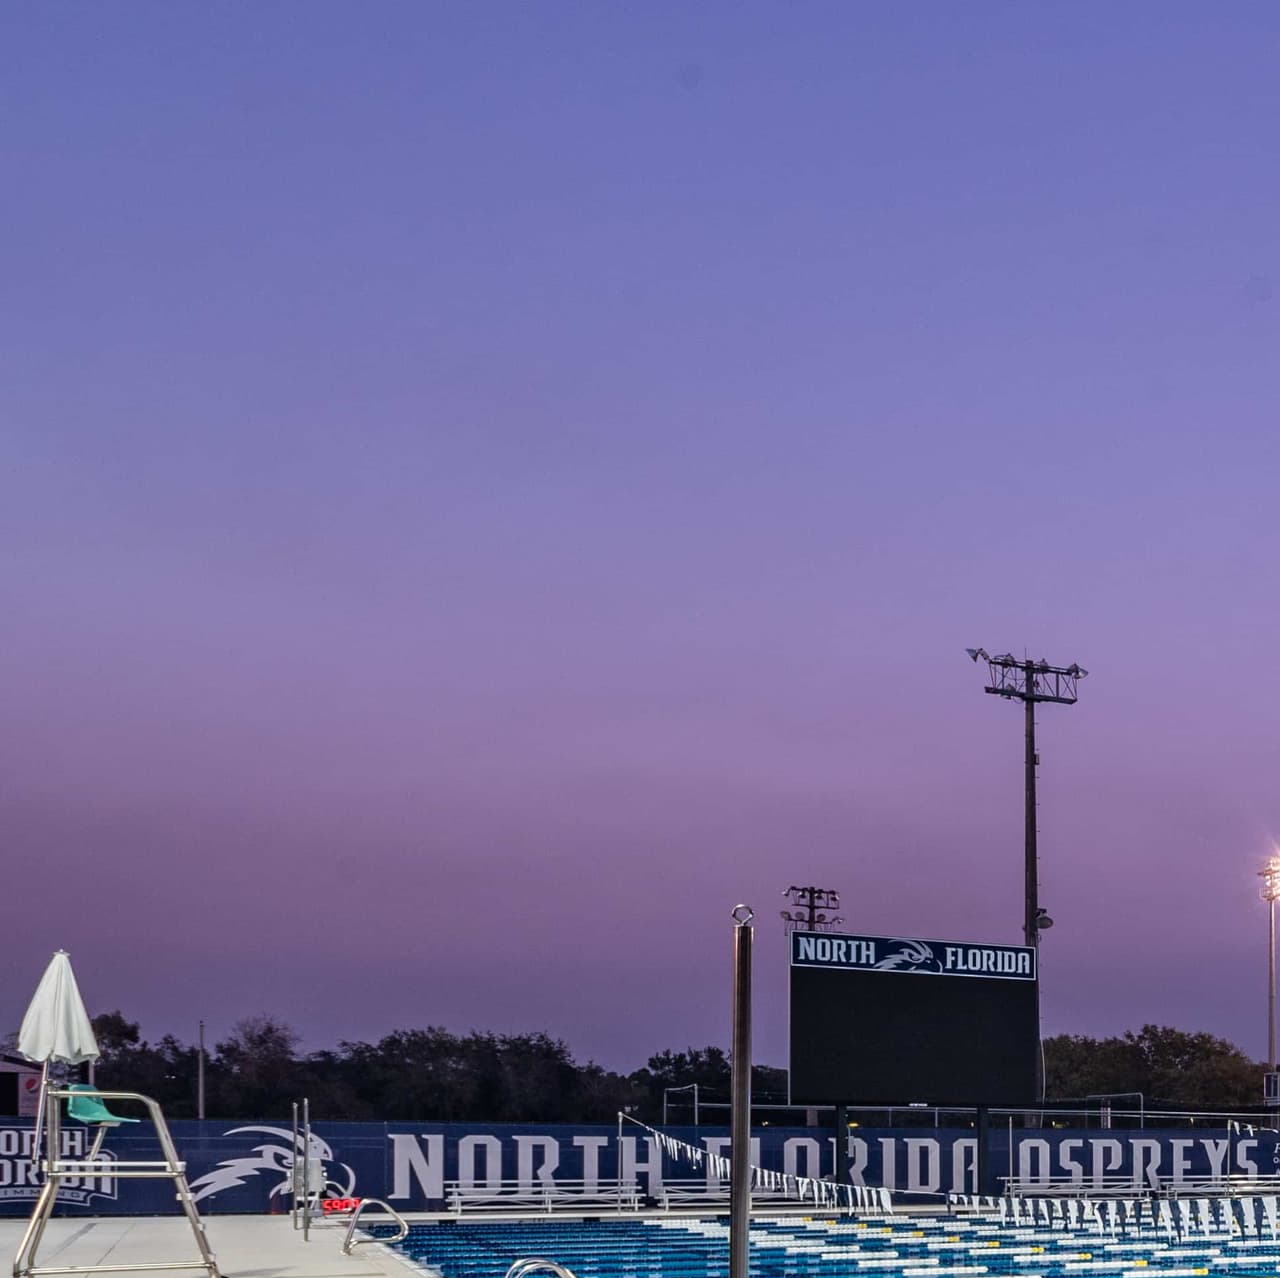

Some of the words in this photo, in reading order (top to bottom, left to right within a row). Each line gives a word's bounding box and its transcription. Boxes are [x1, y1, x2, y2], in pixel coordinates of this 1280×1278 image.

[798, 936, 876, 964] NORTH
[944, 946, 1030, 974] FLORIDA
[387, 1134, 663, 1200] NORTH
[1018, 1138, 1258, 1192] OSPREYS
